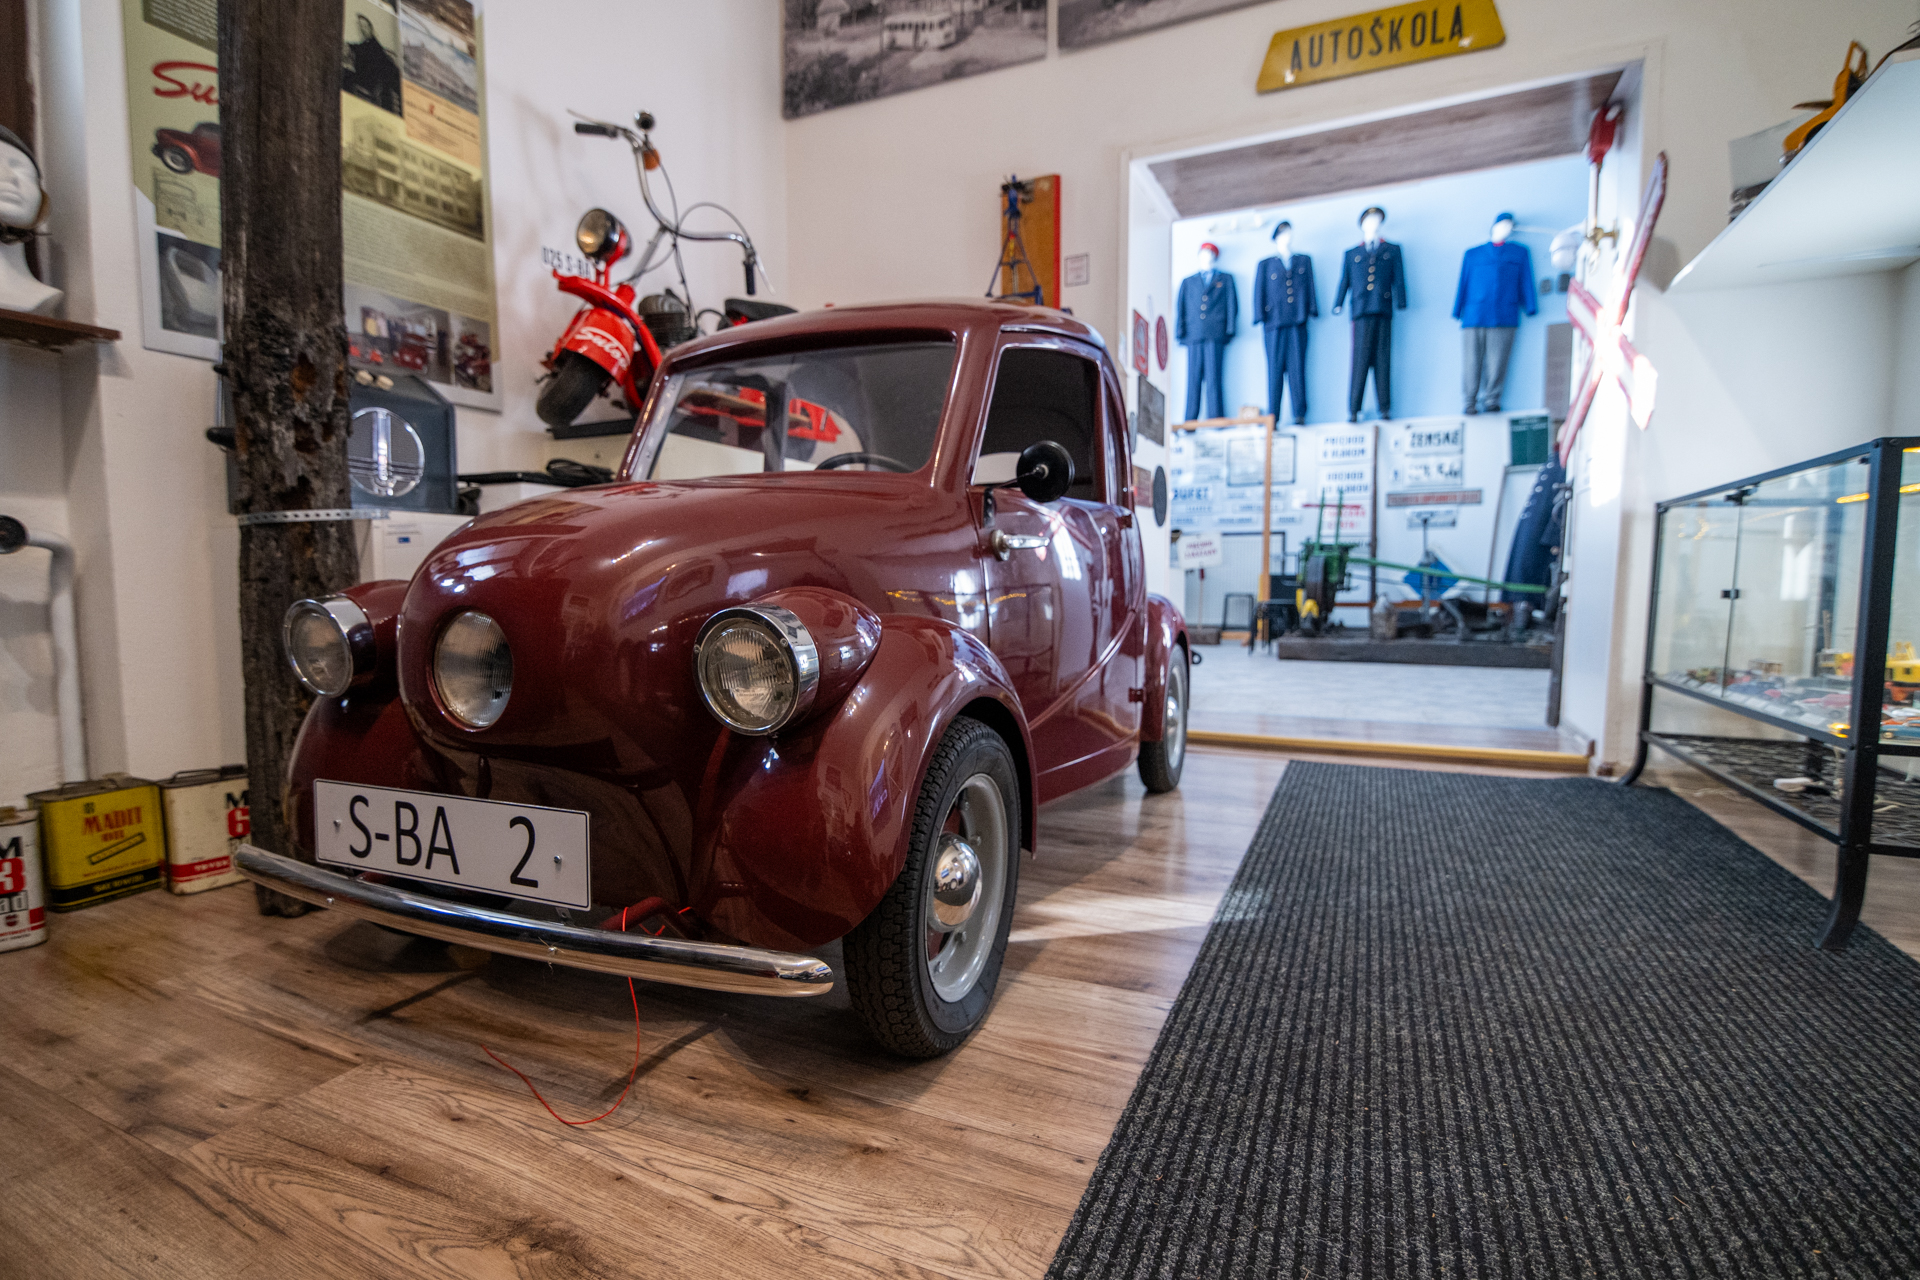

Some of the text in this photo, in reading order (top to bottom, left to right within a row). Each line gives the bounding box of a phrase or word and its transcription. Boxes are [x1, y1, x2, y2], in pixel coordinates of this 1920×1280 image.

[1290, 4, 1464, 72] AUTOŠKOLA
[349, 794, 539, 888] S-BA 2
